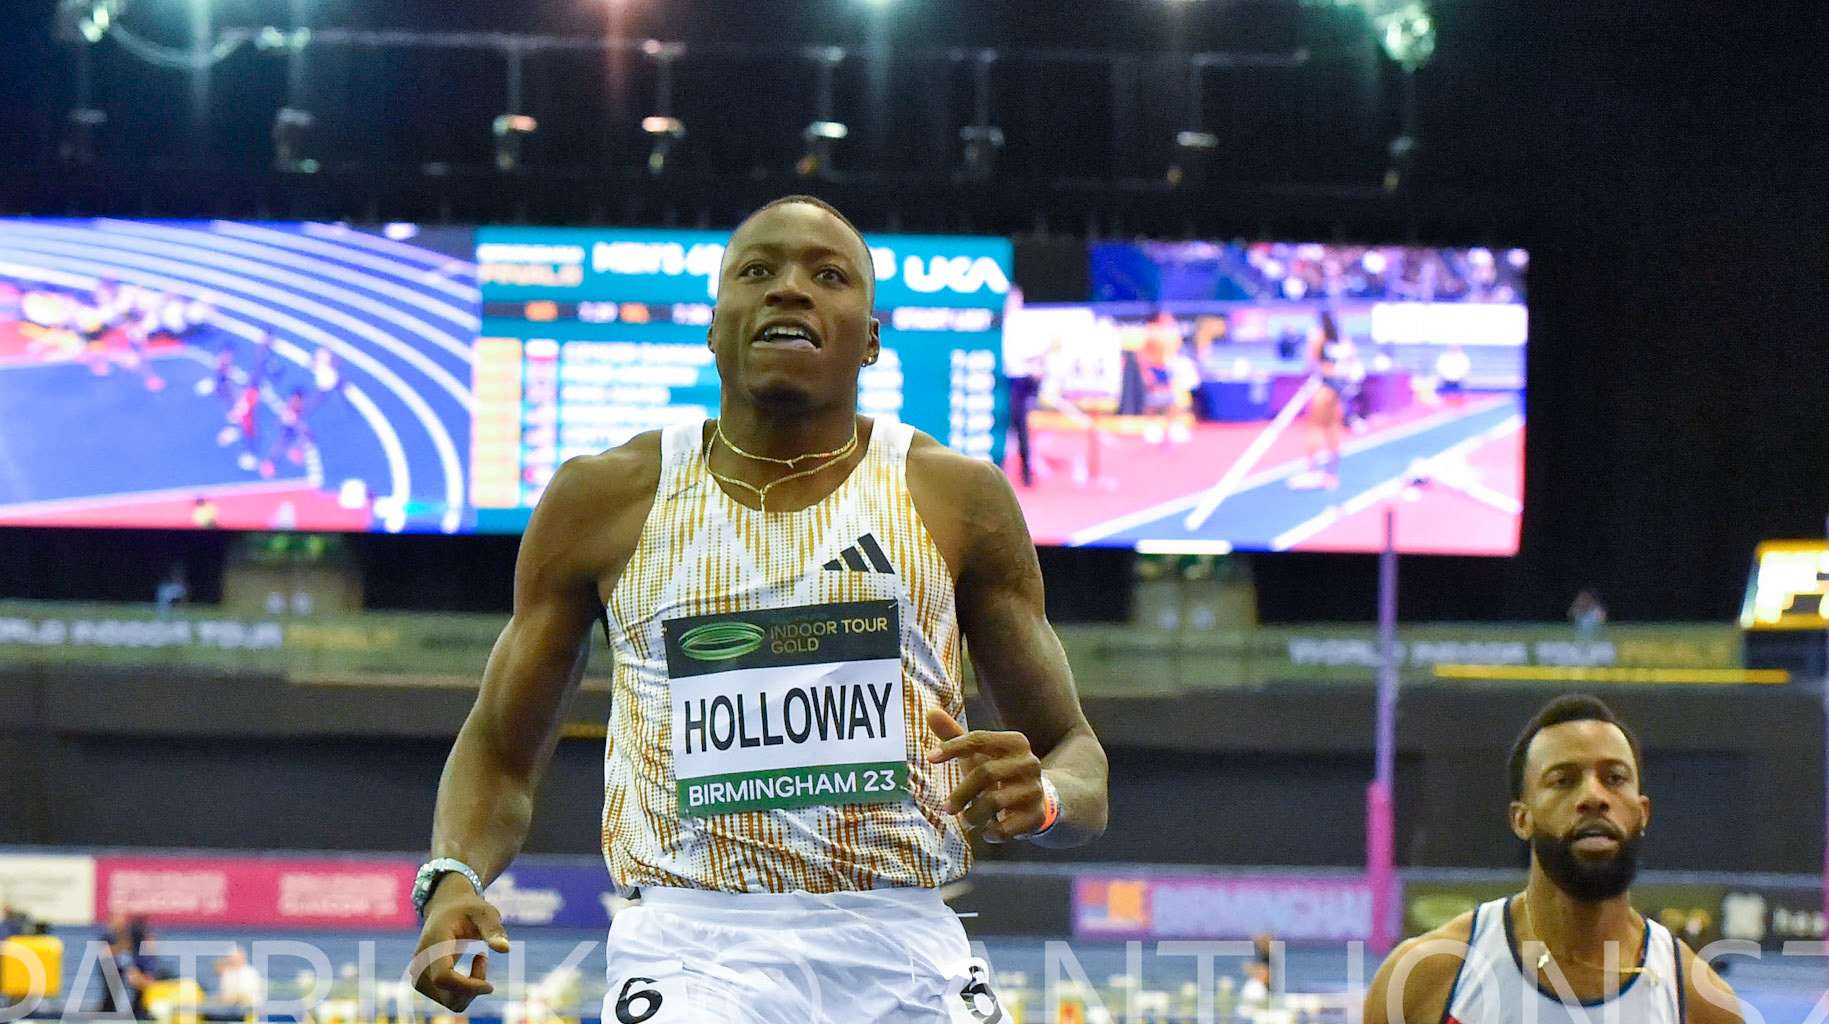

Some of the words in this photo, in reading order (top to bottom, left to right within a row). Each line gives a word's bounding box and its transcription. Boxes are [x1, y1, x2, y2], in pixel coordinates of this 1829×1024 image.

[904, 255, 1011, 293] UKA
[770, 620, 838, 640] INDOOR
[840, 617, 888, 634] TOUR
[770, 637, 819, 654] GOLD
[684, 682, 893, 755] HOLLOWAY
[688, 772, 857, 807] BIRMINGHAM
[863, 769, 896, 792] 23
[615, 977, 663, 1024] 6
